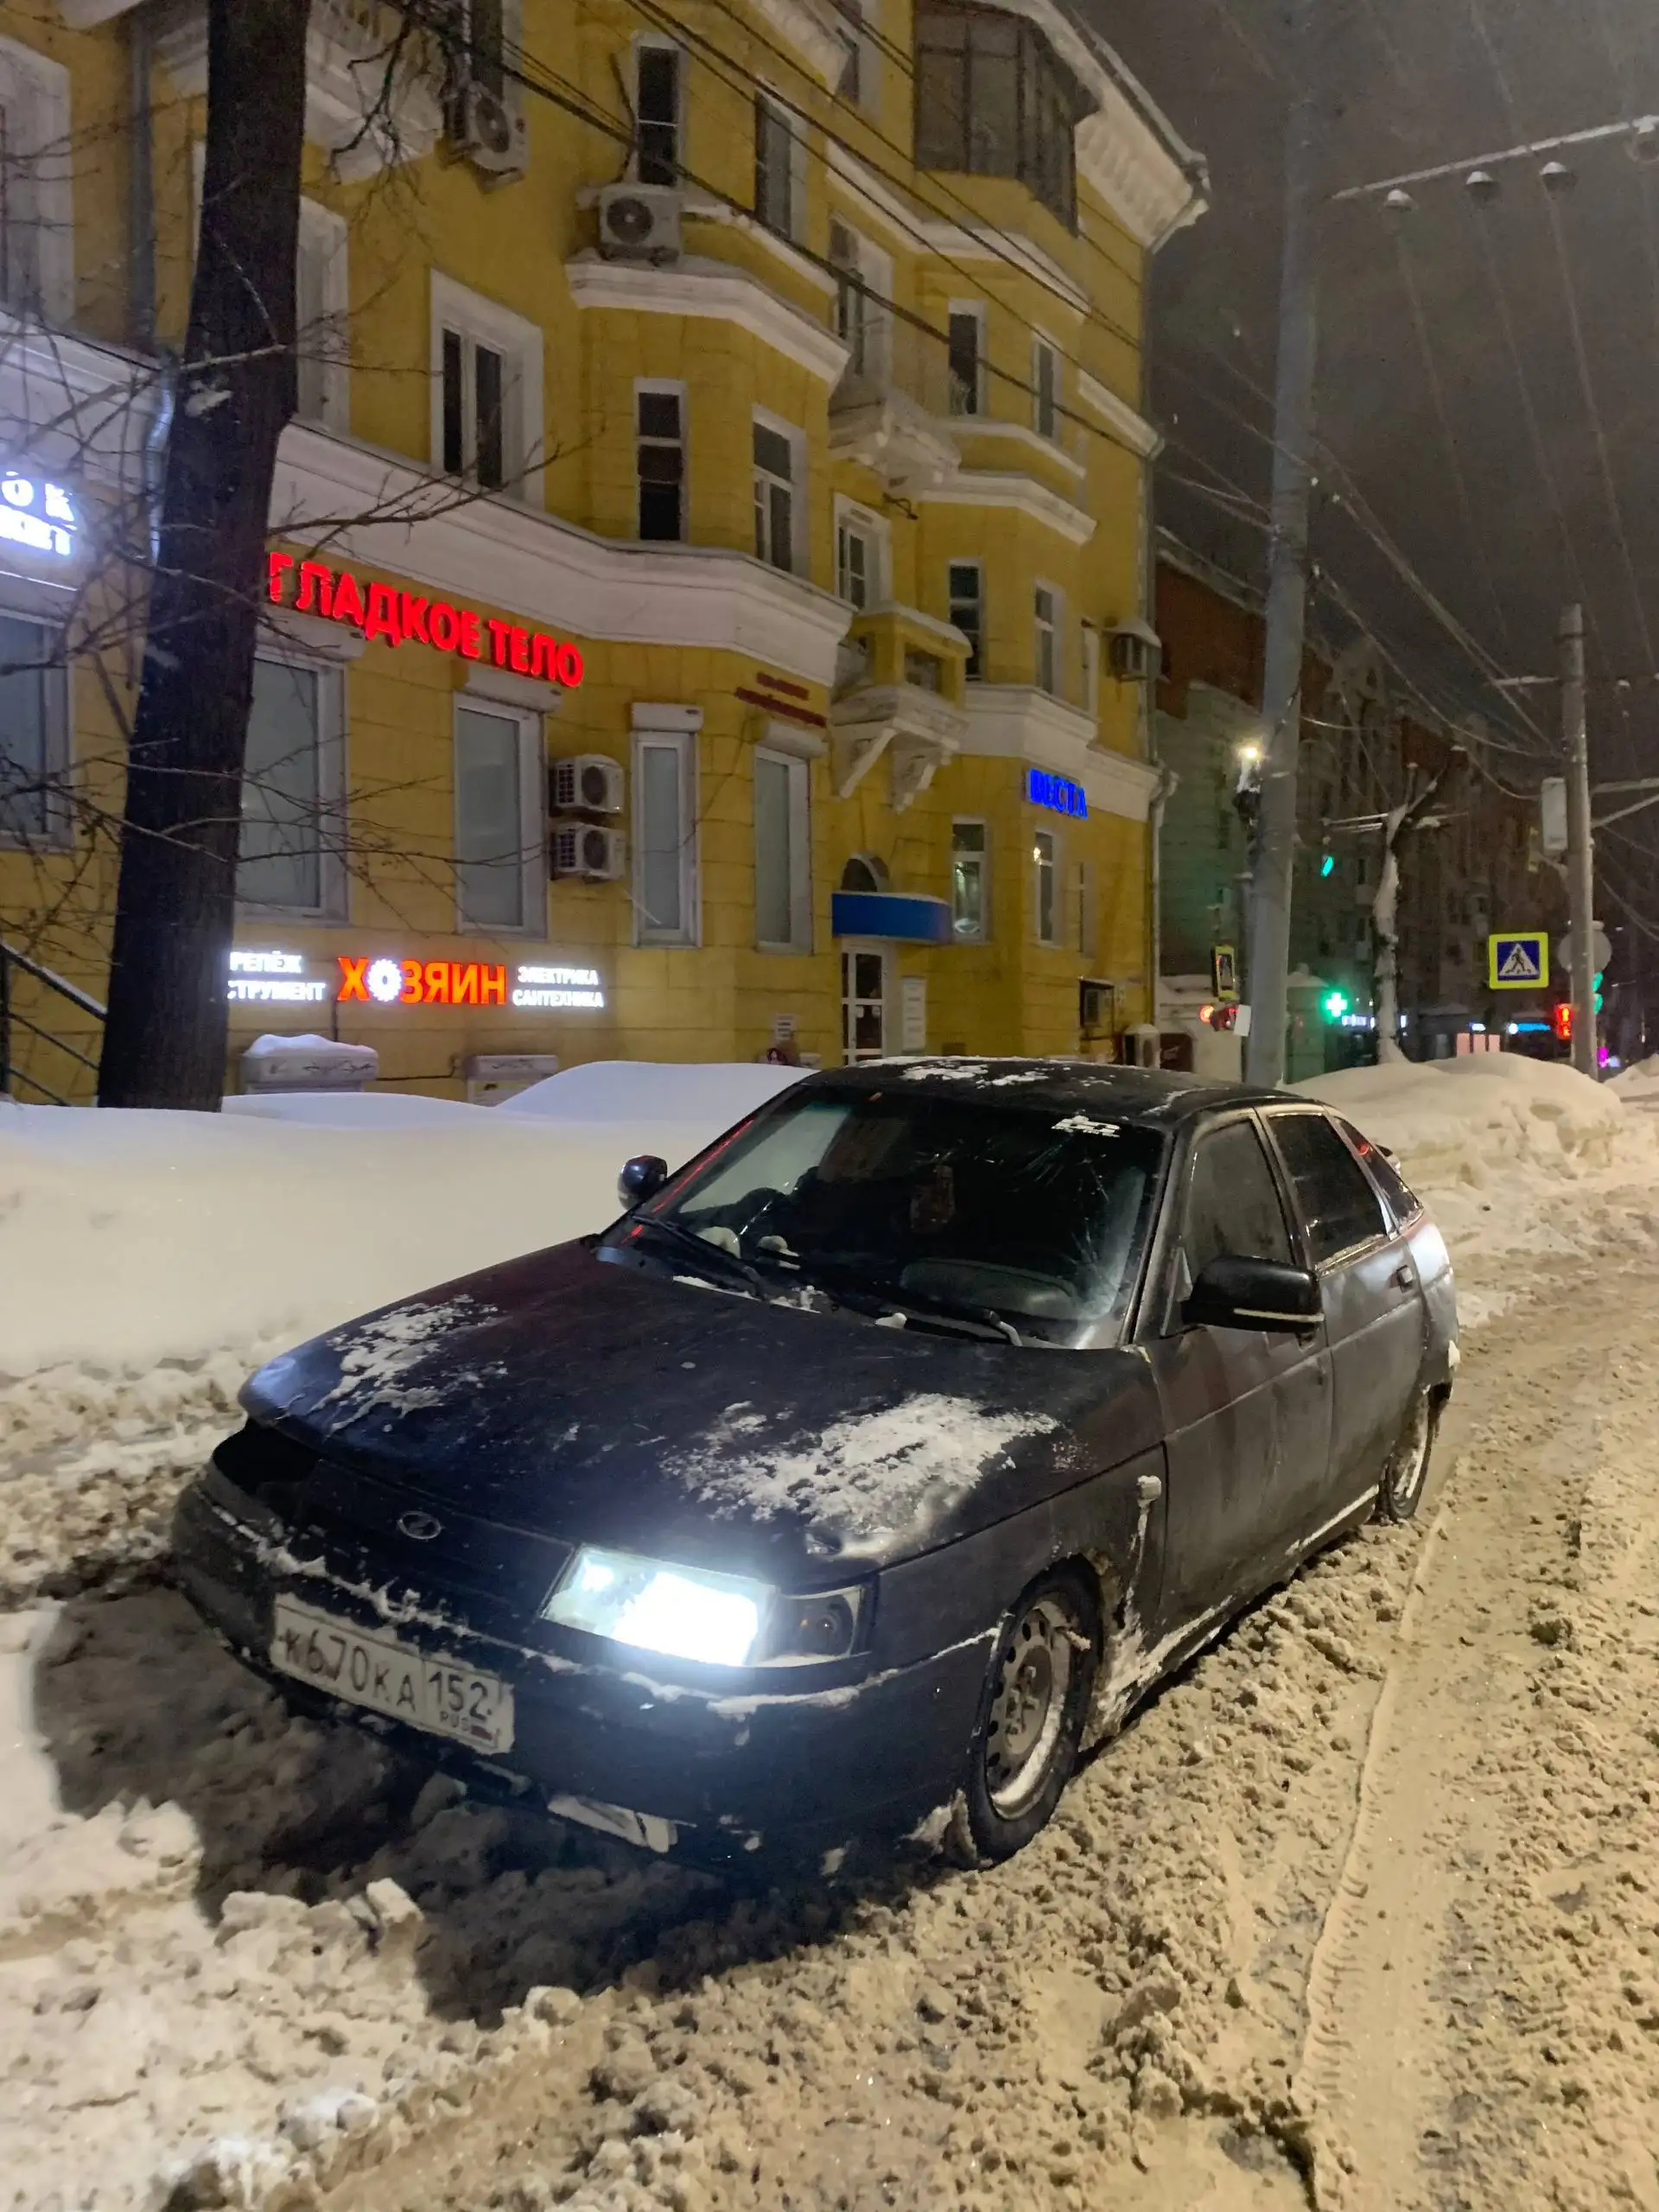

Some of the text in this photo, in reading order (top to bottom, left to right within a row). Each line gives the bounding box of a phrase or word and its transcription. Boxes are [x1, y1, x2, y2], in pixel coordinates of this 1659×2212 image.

[270, 551, 584, 688] ГЛАДКОЕ ТЕЛО
[337, 957, 506, 1005] ХОЗЯИН
[517, 965, 599, 986] ЭЛЕКТРИКА
[512, 988, 604, 1008] САНТЕХНИКА
[429, 1671, 487, 1721] 152
[439, 1711, 471, 1732] RUS
